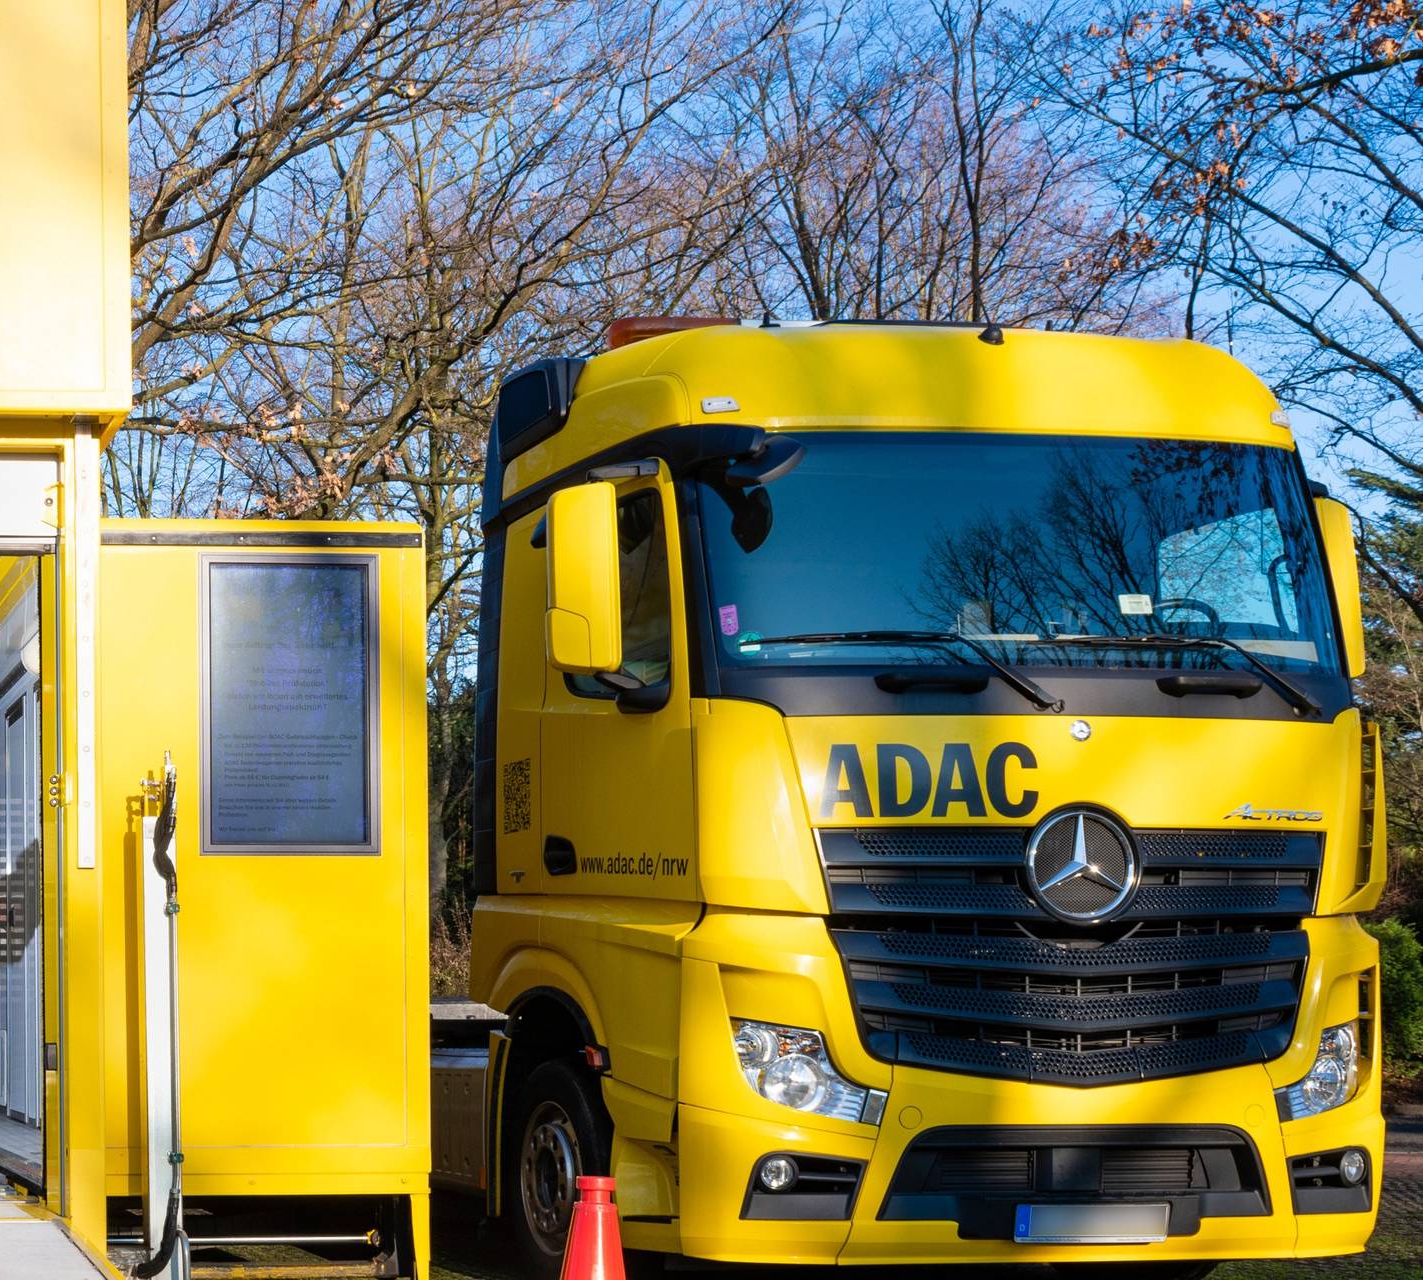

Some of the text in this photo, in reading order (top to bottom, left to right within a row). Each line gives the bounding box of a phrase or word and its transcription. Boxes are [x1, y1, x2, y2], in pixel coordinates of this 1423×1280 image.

[819, 741, 1040, 819] ADAC
[1223, 802, 1323, 821] ACTROS
[580, 852, 689, 881] www.adac.de/nrw
